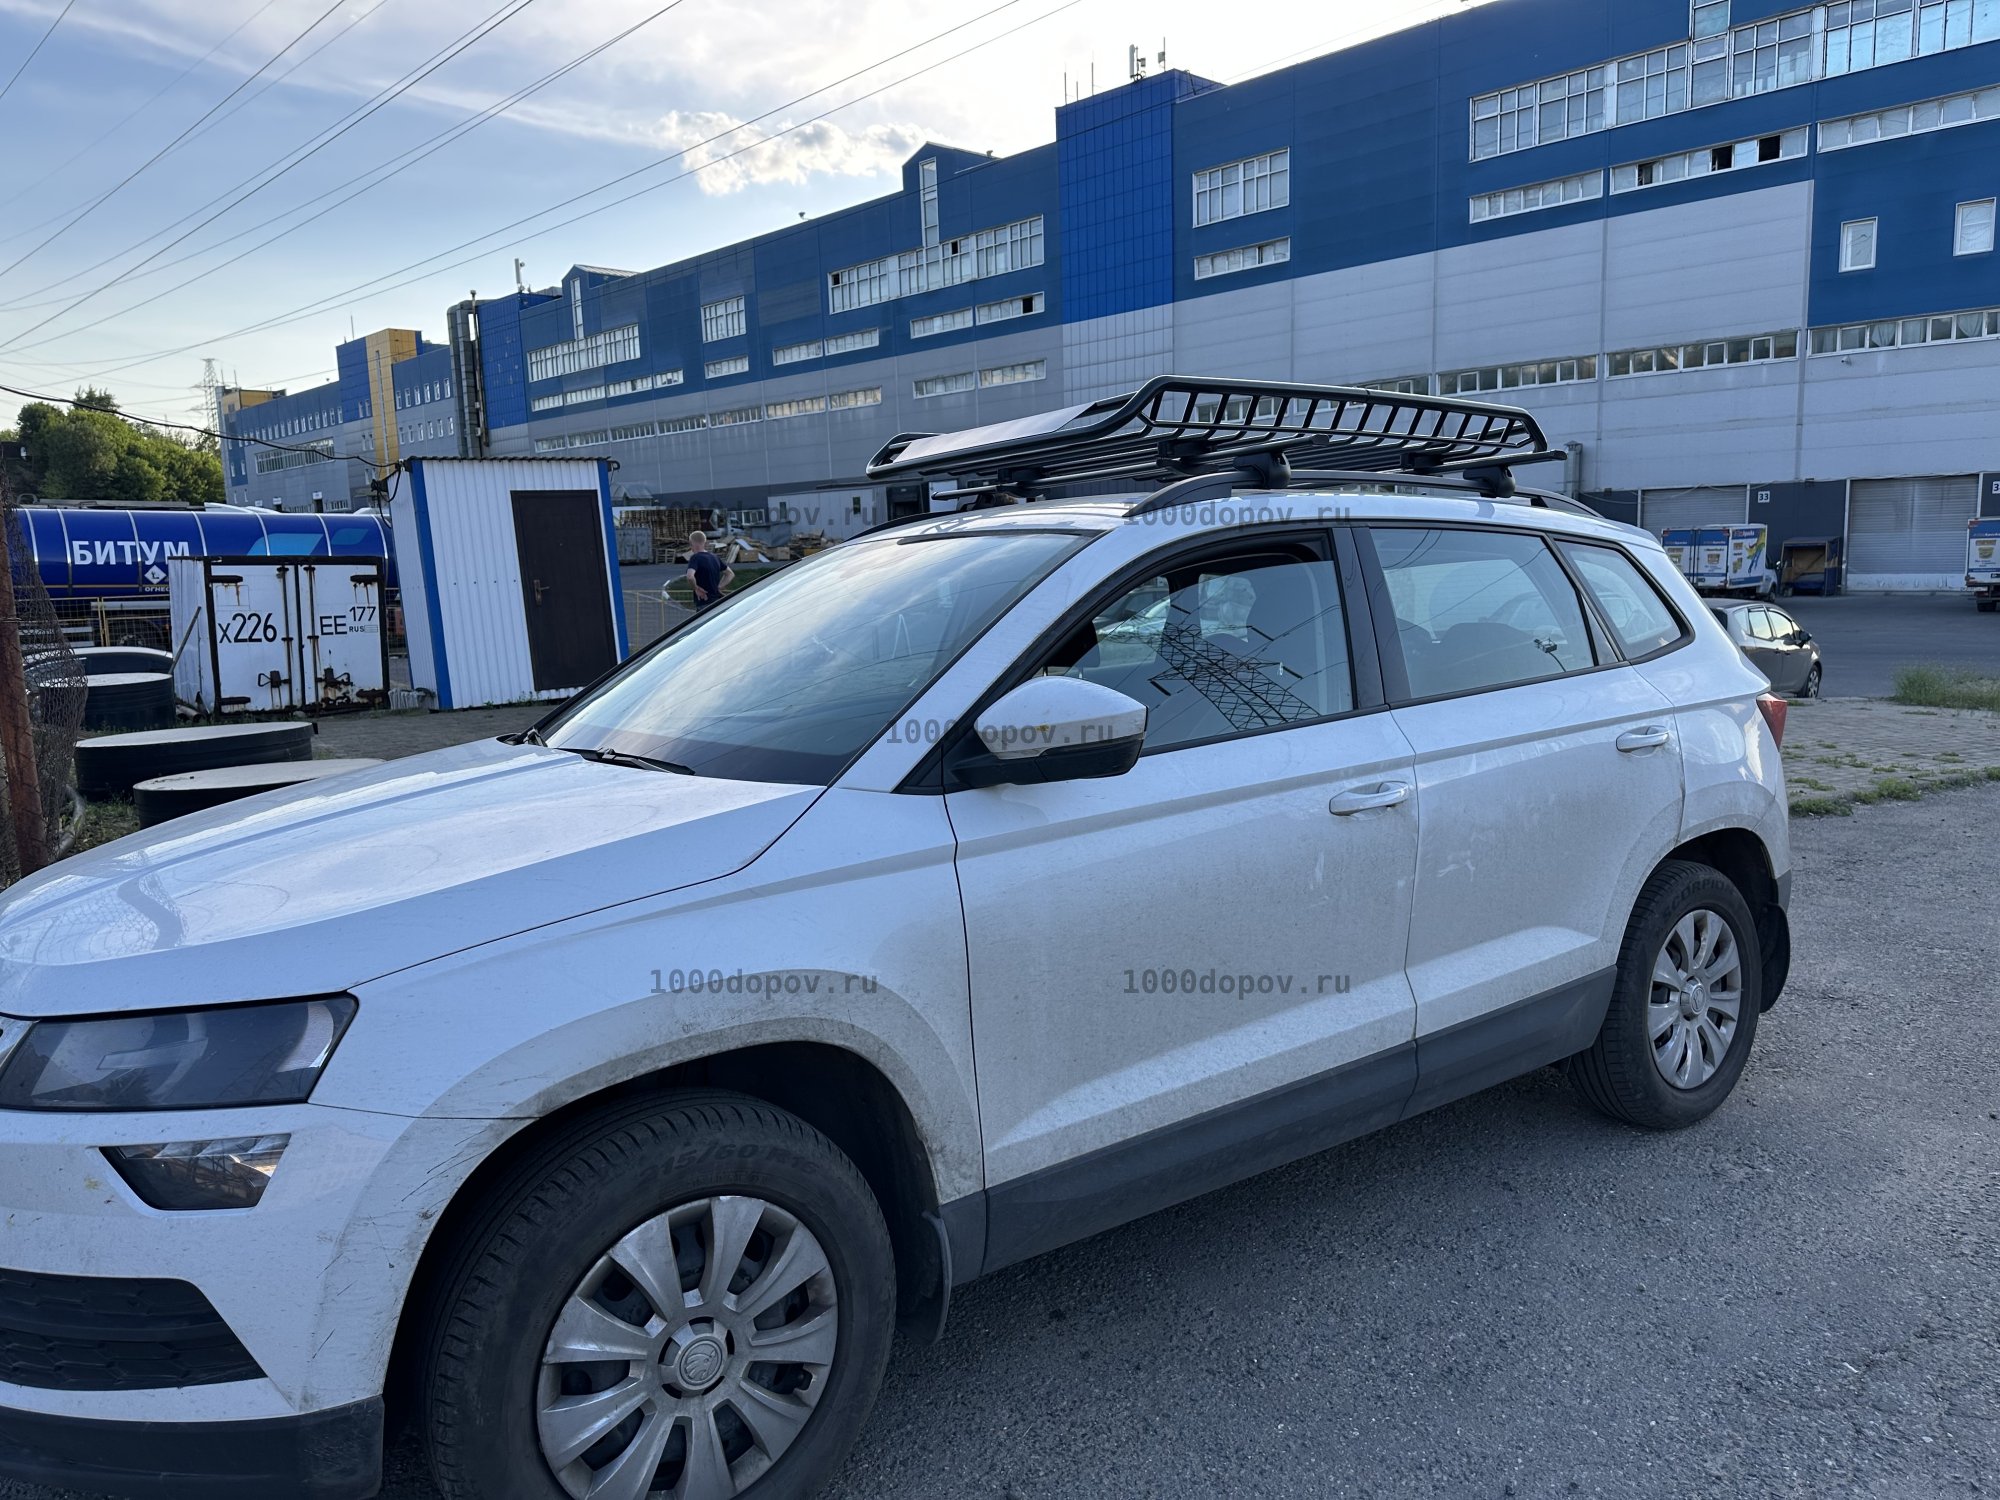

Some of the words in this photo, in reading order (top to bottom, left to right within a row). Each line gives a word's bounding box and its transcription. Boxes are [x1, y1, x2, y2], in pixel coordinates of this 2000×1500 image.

[1758, 492, 1769, 501] 33
[72, 540, 190, 566] БИТУМ
[349, 606, 376, 621] 177
